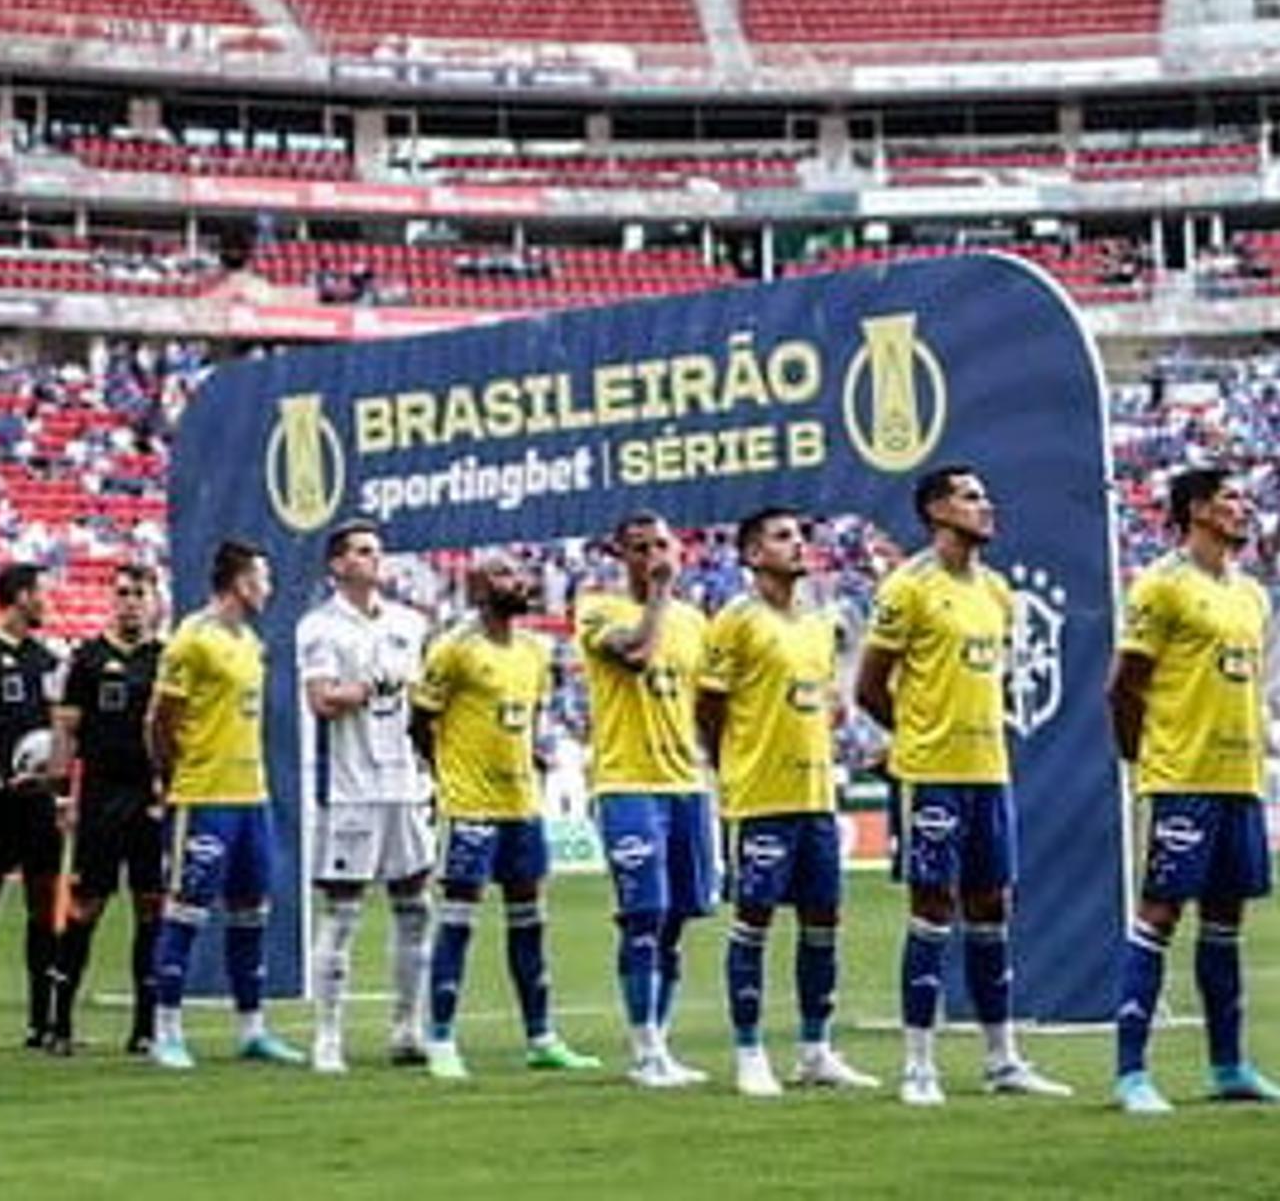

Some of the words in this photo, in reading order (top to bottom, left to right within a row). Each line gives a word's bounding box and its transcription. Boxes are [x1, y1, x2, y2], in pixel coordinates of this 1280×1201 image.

[355, 332, 821, 454] BRASILEIRÃO
[360, 447, 593, 519] sportingbet
[619, 424, 778, 486] SÉRIE
[788, 421, 827, 466] B
